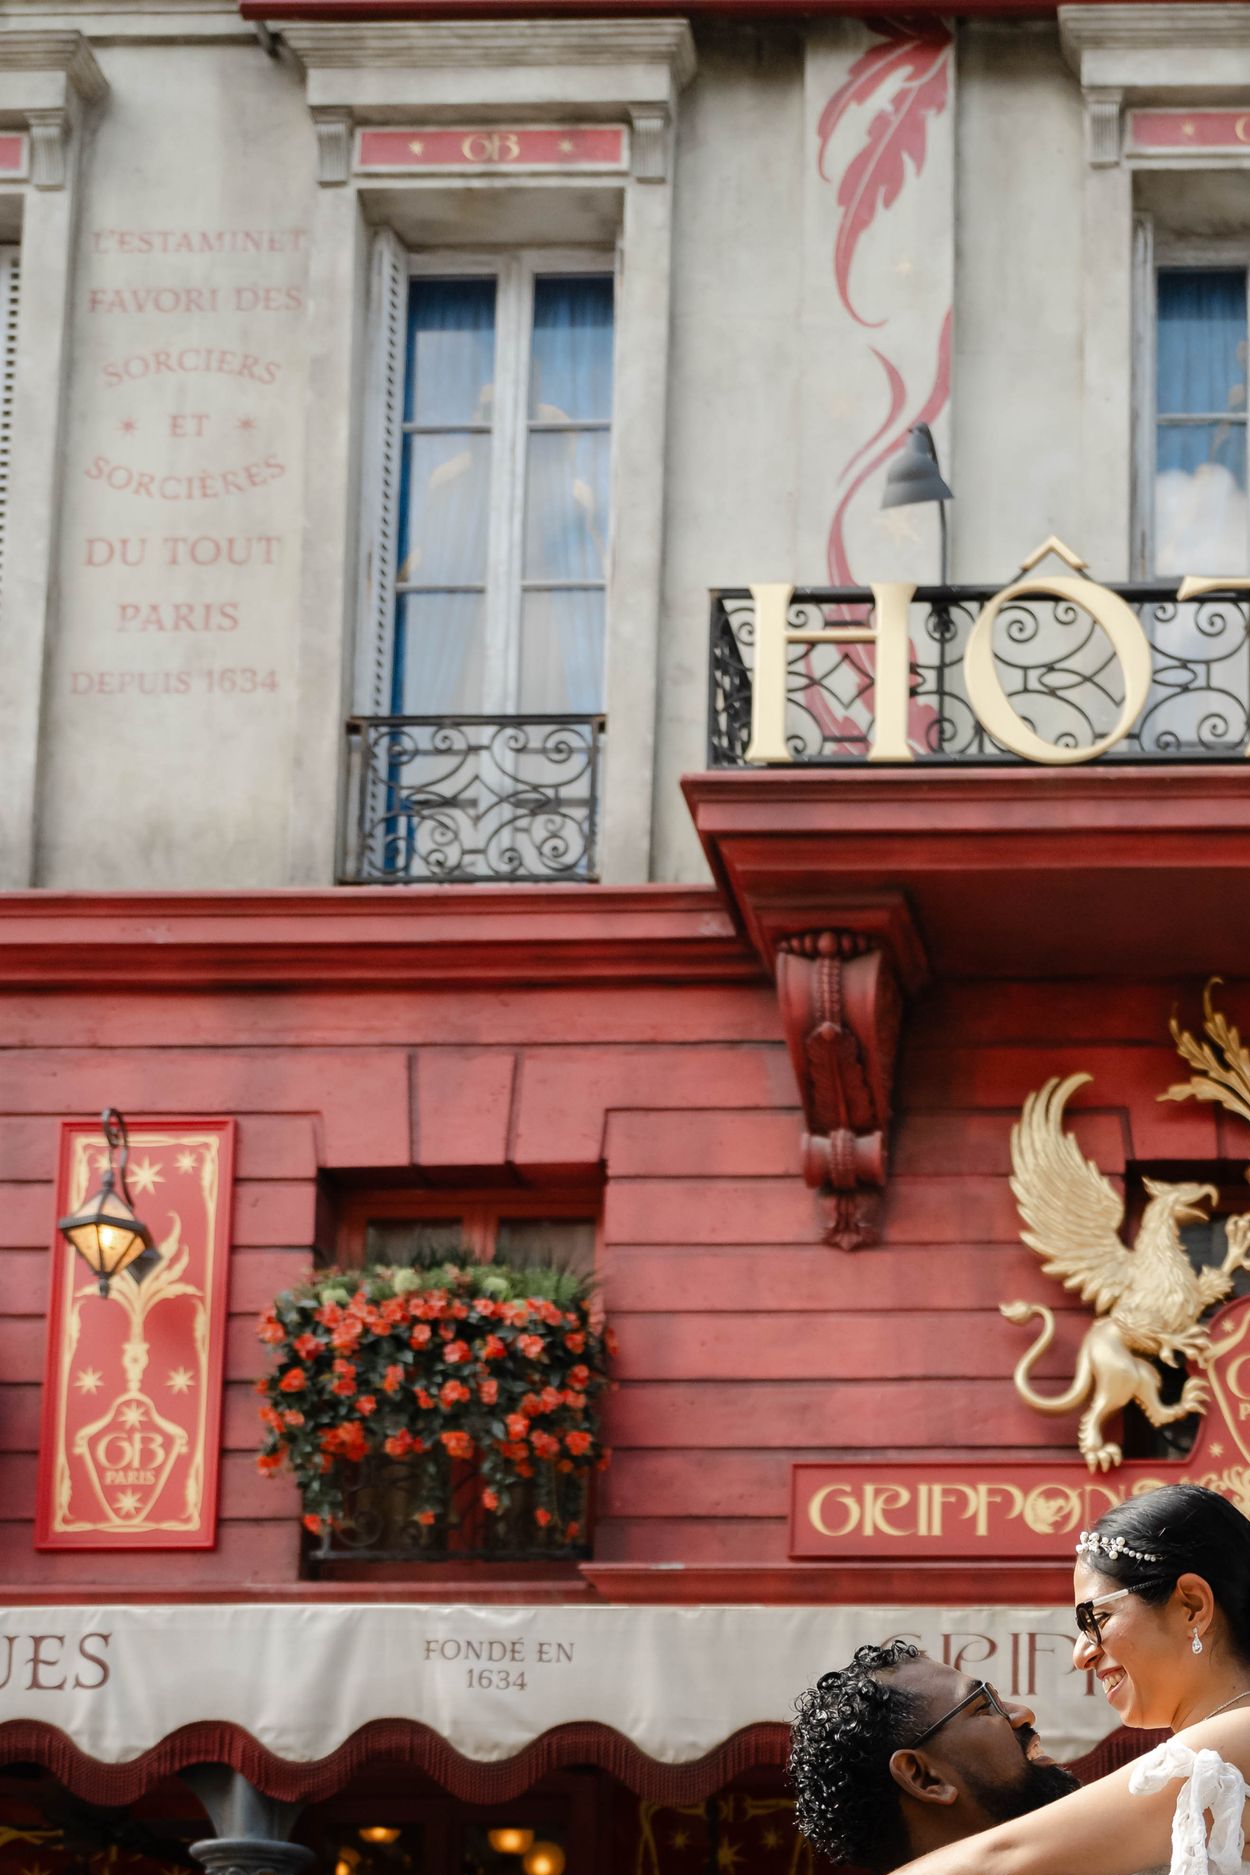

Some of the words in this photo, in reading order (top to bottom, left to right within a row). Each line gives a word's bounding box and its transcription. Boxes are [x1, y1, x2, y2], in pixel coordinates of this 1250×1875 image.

[91, 229, 308, 256] L'ESTAMINET
[89, 287, 217, 314] FAVORI
[235, 286, 303, 311] DES
[105, 348, 281, 387] SORCIERS
[171, 414, 209, 437] ET
[85, 455, 286, 502] SORCIÈRES
[84, 537, 147, 567] DU
[163, 536, 283, 566] TOUT
[117, 602, 240, 633] PARIS
[71, 671, 191, 695] DEPUIS
[206, 669, 279, 693] 1634
[98, 1432, 166, 1470] GB
[105, 1471, 156, 1485] PARIS
[424, 1637, 526, 1664] FONDÉ
[536, 1641, 576, 1663] EN
[466, 1668, 528, 1692] 1634
